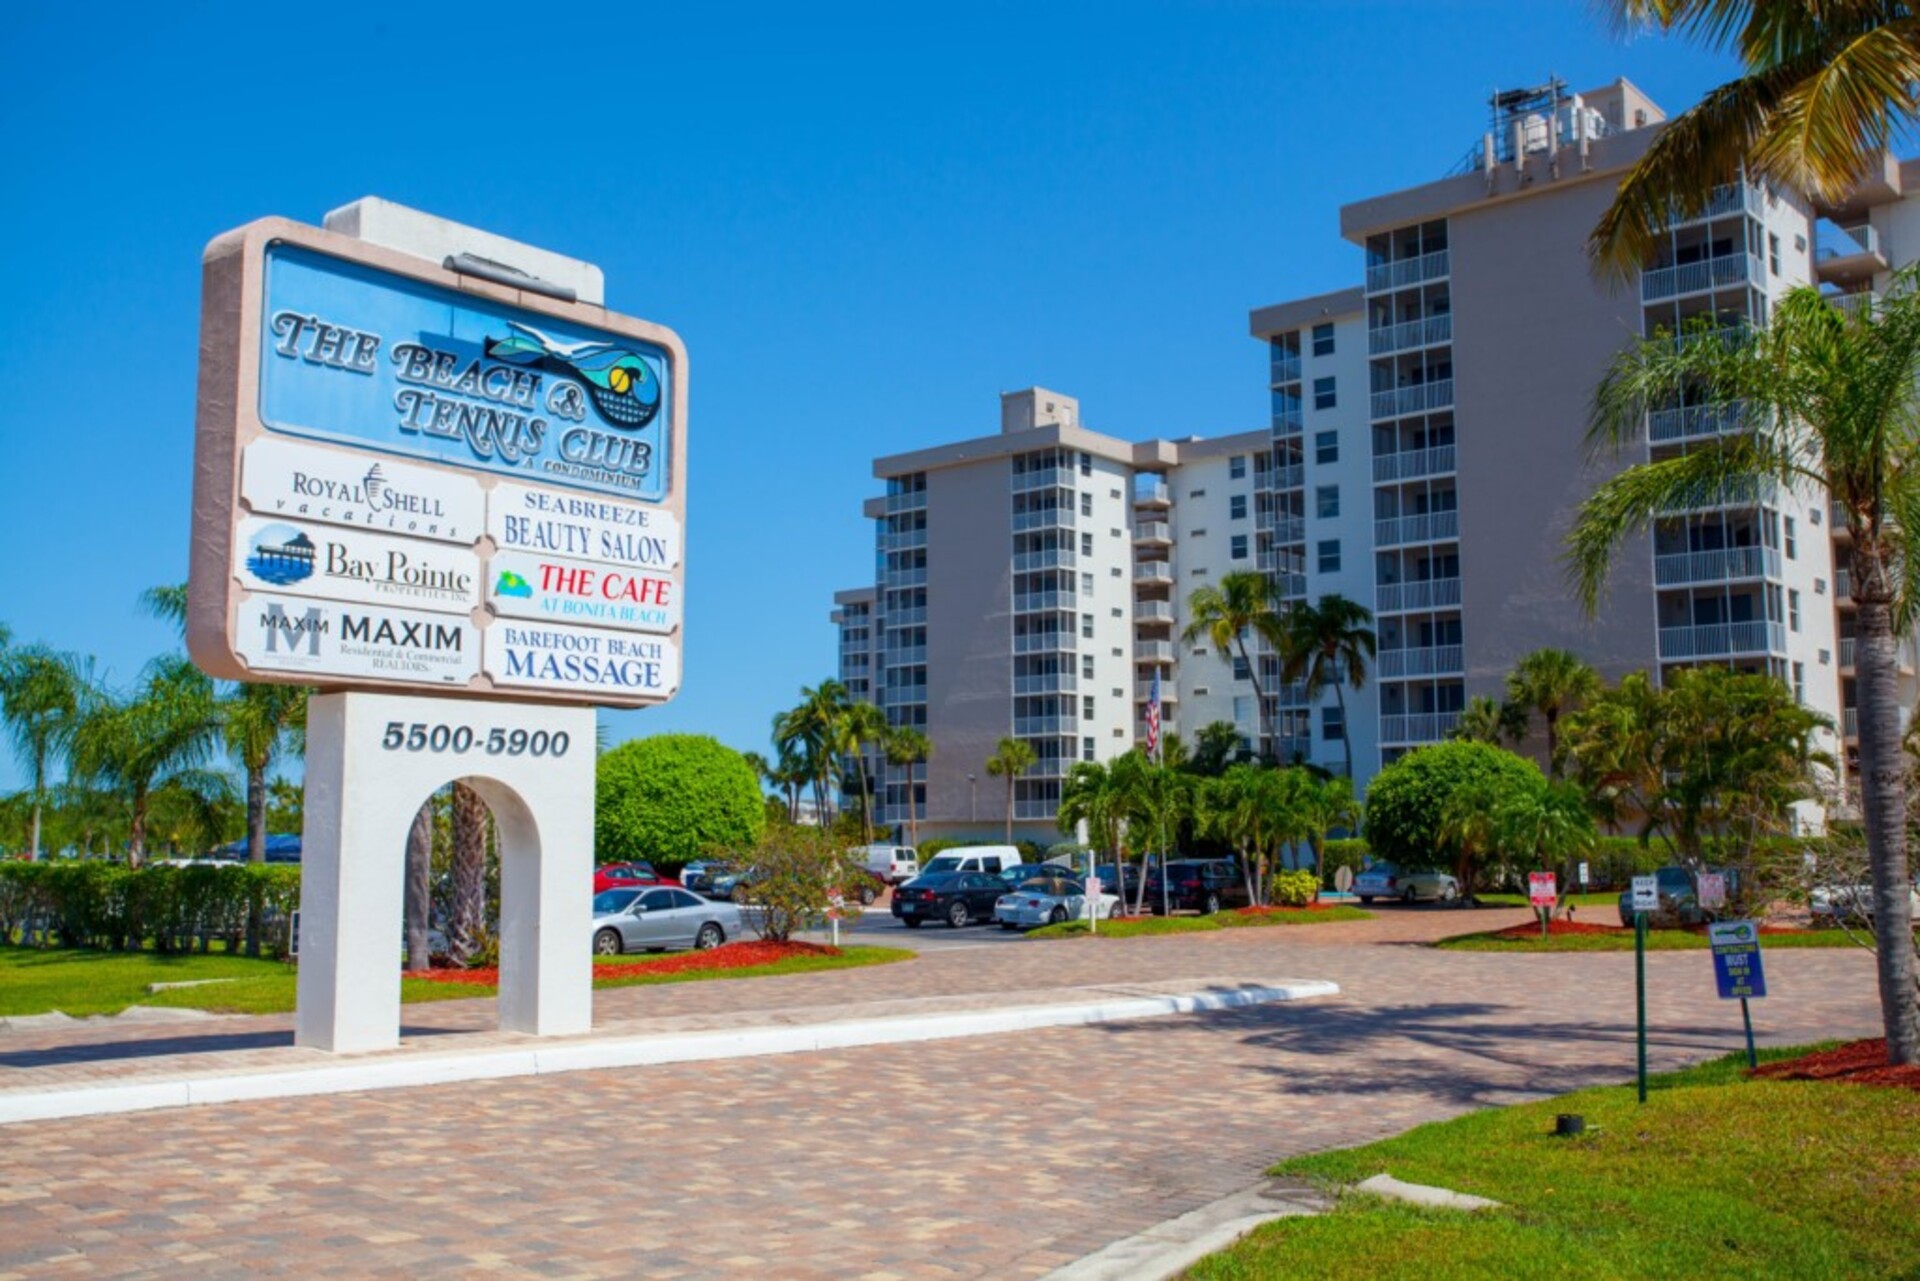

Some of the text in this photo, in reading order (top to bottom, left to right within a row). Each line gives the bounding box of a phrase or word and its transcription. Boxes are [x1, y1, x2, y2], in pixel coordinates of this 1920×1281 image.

[272, 312, 586, 422] THE BEACH &
[395, 389, 652, 478] TENNIS CLUB
[522, 457, 641, 489] A CONDOMINIUM
[293, 472, 445, 517] ROYAL SHELL
[525, 492, 649, 528] SEABREEZE
[277, 499, 457, 537] vacations
[505, 515, 667, 566] BEAUTY SALON
[326, 542, 471, 591] Bay Pointe
[540, 564, 672, 606] THE CAFE
[260, 613, 329, 634] MAXIM
[541, 598, 667, 624] AT BONITA BEACH
[340, 614, 462, 652] MAXIM
[505, 628, 661, 660] BAREFOOT BEACH
[341, 644, 393, 659] Residential
[406, 652, 462, 665] Commercial
[505, 649, 662, 689] MASSAGE
[382, 721, 570, 758] 5500-5900
